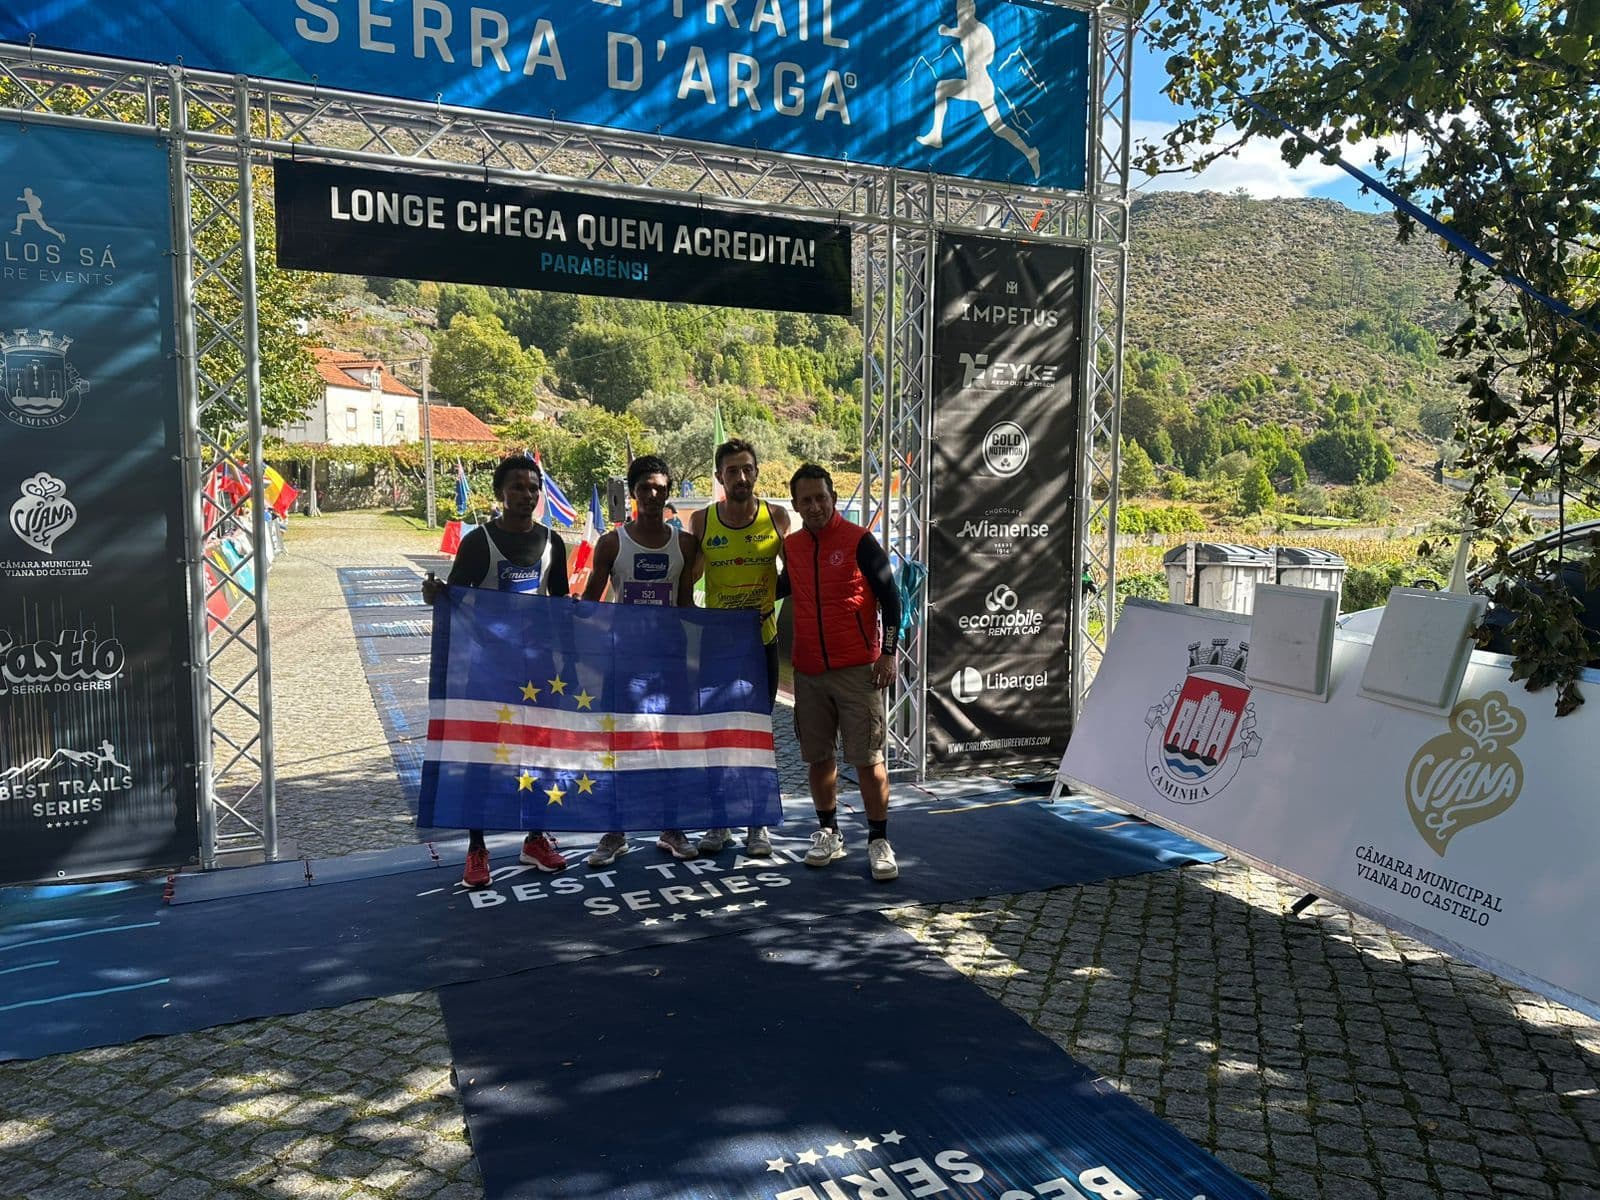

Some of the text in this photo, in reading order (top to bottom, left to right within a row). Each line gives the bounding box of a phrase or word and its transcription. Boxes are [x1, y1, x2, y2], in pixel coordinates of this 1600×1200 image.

[295, 0, 567, 81] SERRA
[331, 186, 815, 267] LONGE CHEGA QUEM ACREDITA!
[80, 244, 116, 268] SÁ
[540, 252, 649, 281] PARABÉNS!
[40, 269, 114, 286] EVENTS
[962, 303, 1059, 327] IMPETUS
[9, 410, 67, 426] CAMINHA
[988, 446, 1023, 456] NUTRITION
[992, 433, 1021, 446] GOLD
[14, 500, 74, 537] VIANA
[0, 560, 92, 569] CÂMARA MUNICIPAL
[5, 569, 34, 577] VIANA
[49, 568, 89, 576] CASTELO
[958, 609, 1044, 629] ecomobile
[988, 626, 1012, 637] RENT
[1013, 626, 1021, 635] A
[1022, 625, 1041, 635] CAR
[12, 683, 51, 695] SERRA
[54, 683, 70, 692] DO
[986, 670, 1048, 691] Libargel
[0, 775, 133, 801] BEST TRAILS
[1151, 765, 1210, 801] CAMINHA
[1411, 747, 1516, 813] VIANA
[33, 797, 102, 817] SERIES
[468, 870, 618, 909] BEST
[1355, 846, 1503, 913] CÂMARA MUNICIPAL
[583, 872, 792, 916] SERIES
[1357, 863, 1490, 927] VIANA DO CASTELO
